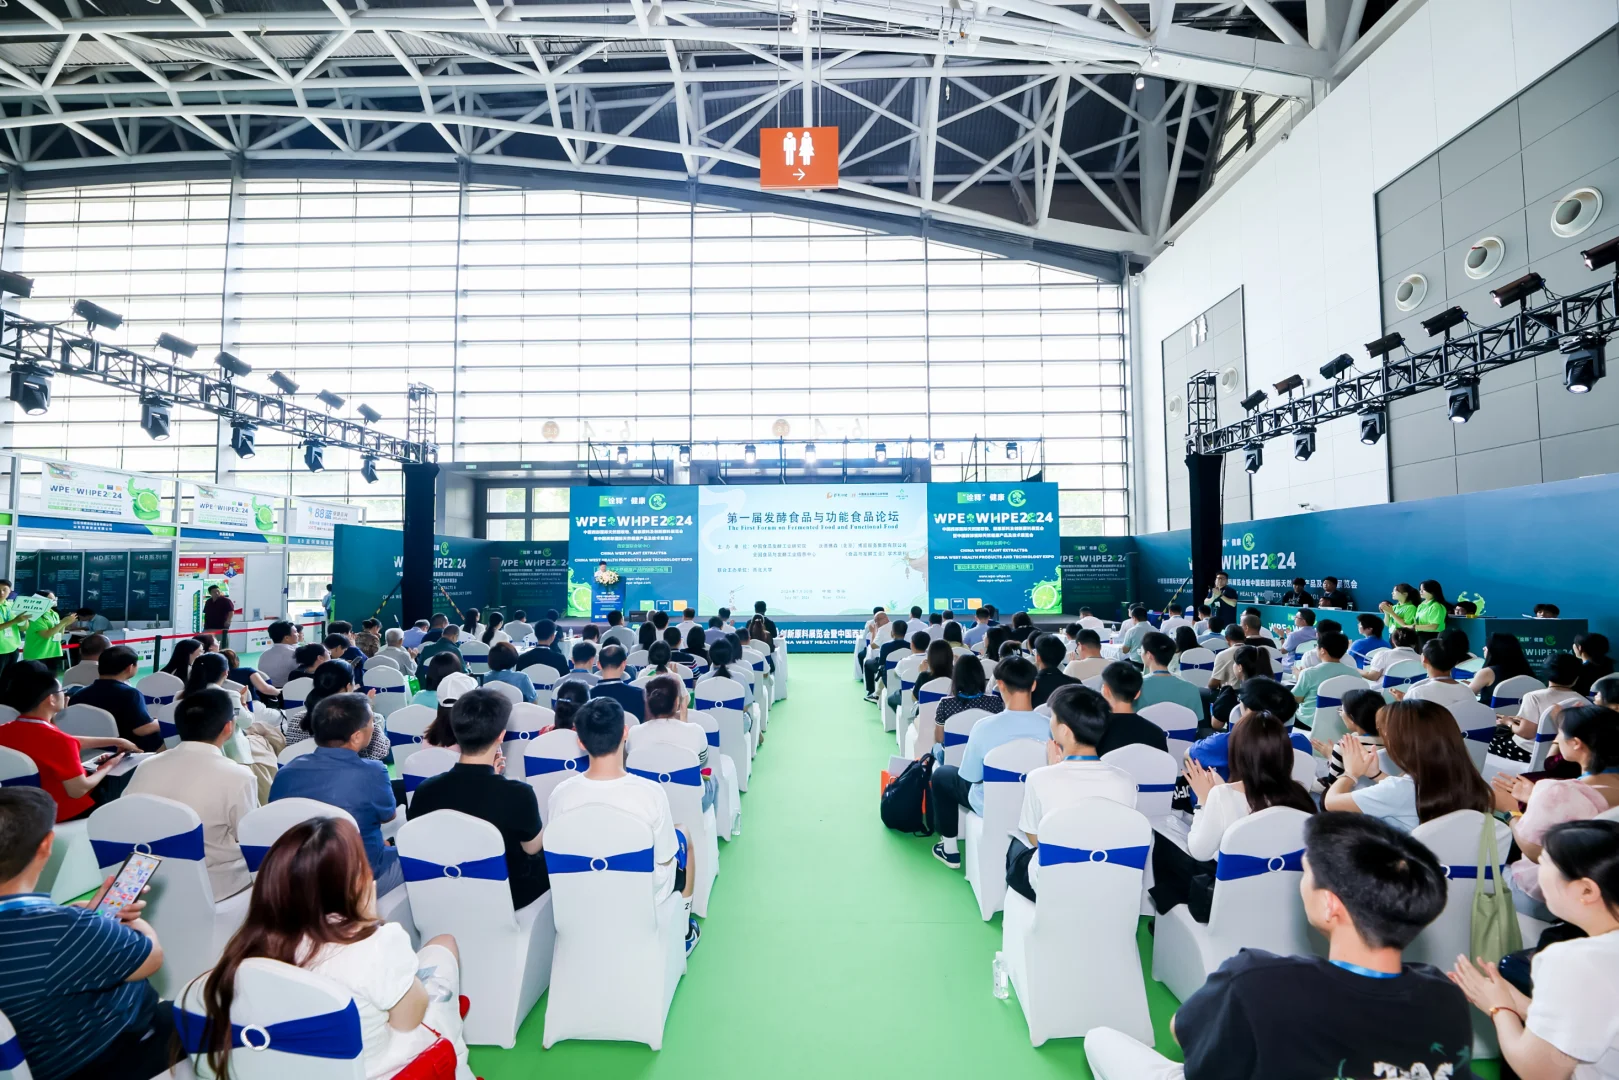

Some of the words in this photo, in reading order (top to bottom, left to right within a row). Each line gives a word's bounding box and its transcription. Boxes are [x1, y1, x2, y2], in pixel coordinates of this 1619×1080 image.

[631, 497, 646, 505] 健康
[575, 516, 607, 527] WPE
[727, 510, 900, 524] 第一届发酵食品与功能食品论坛
[933, 513, 965, 524] WPE
